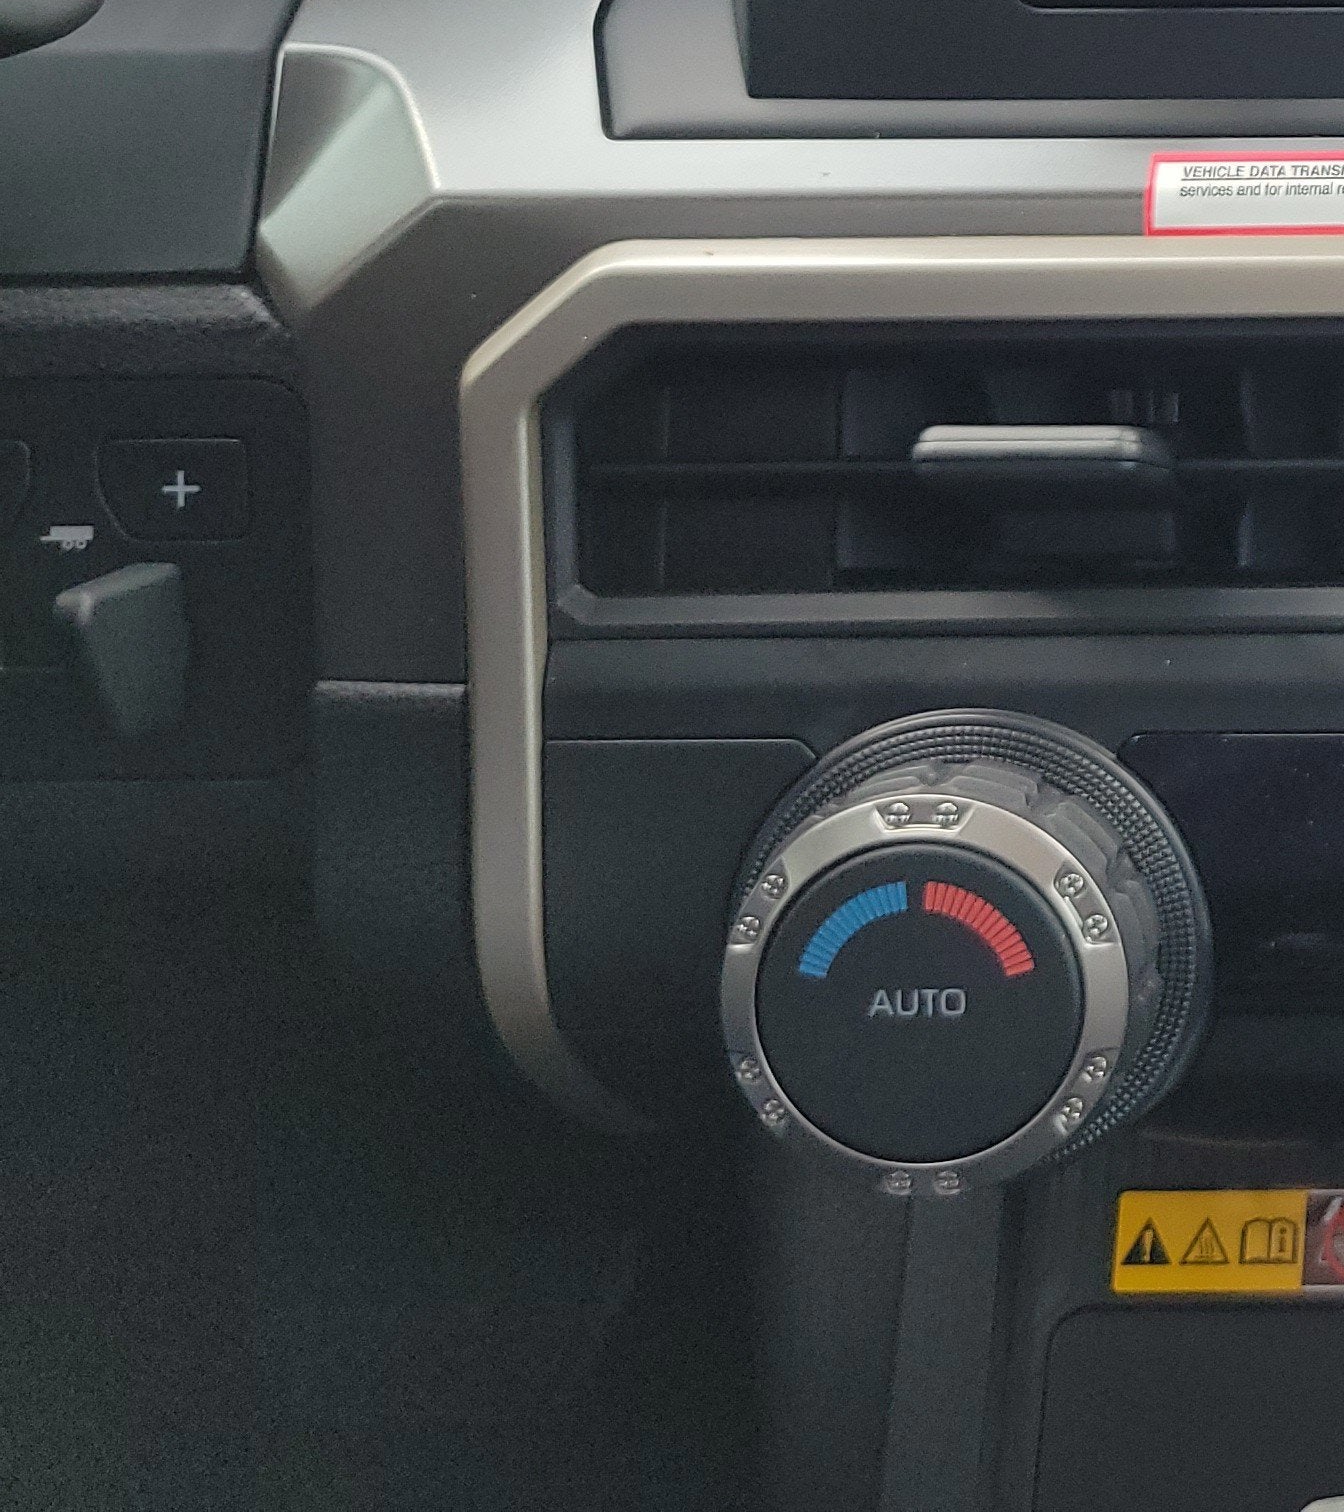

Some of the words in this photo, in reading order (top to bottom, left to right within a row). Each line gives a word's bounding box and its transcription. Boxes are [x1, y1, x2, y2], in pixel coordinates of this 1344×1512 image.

[1183, 164, 1245, 178] VEHICLE
[1249, 164, 1286, 177] DATA
[1180, 184, 1233, 197] services
[1236, 183, 1261, 196] and
[1264, 183, 1282, 196] for
[1286, 182, 1333, 196] internal
[868, 988, 967, 1017] AUTO
